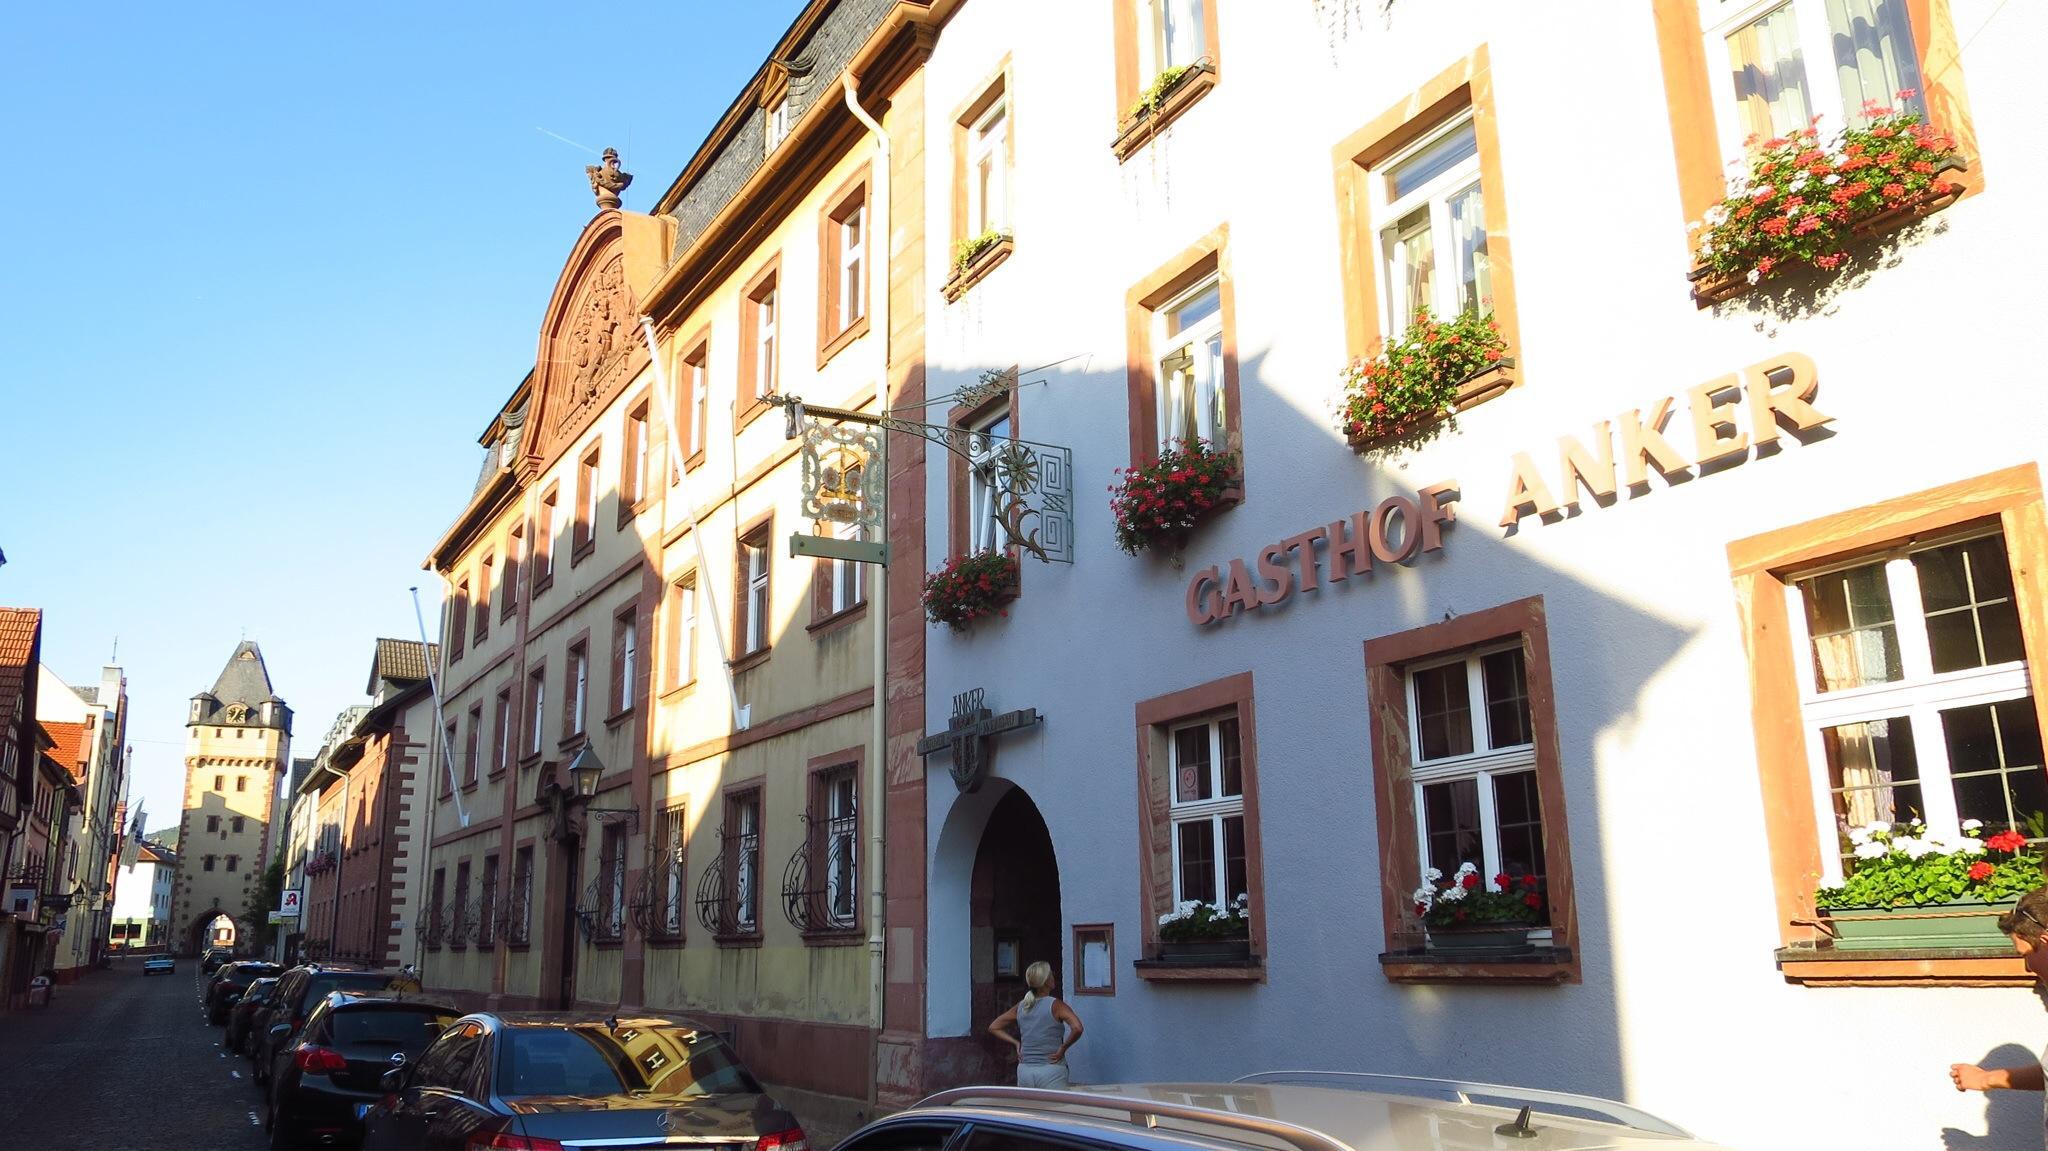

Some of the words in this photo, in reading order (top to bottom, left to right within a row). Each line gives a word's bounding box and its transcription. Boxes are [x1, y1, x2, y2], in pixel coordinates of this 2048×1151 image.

[1186, 480, 1460, 624] GASTHOF
[1499, 351, 1836, 528] ANKER
[952, 687, 985, 717] ANKER
